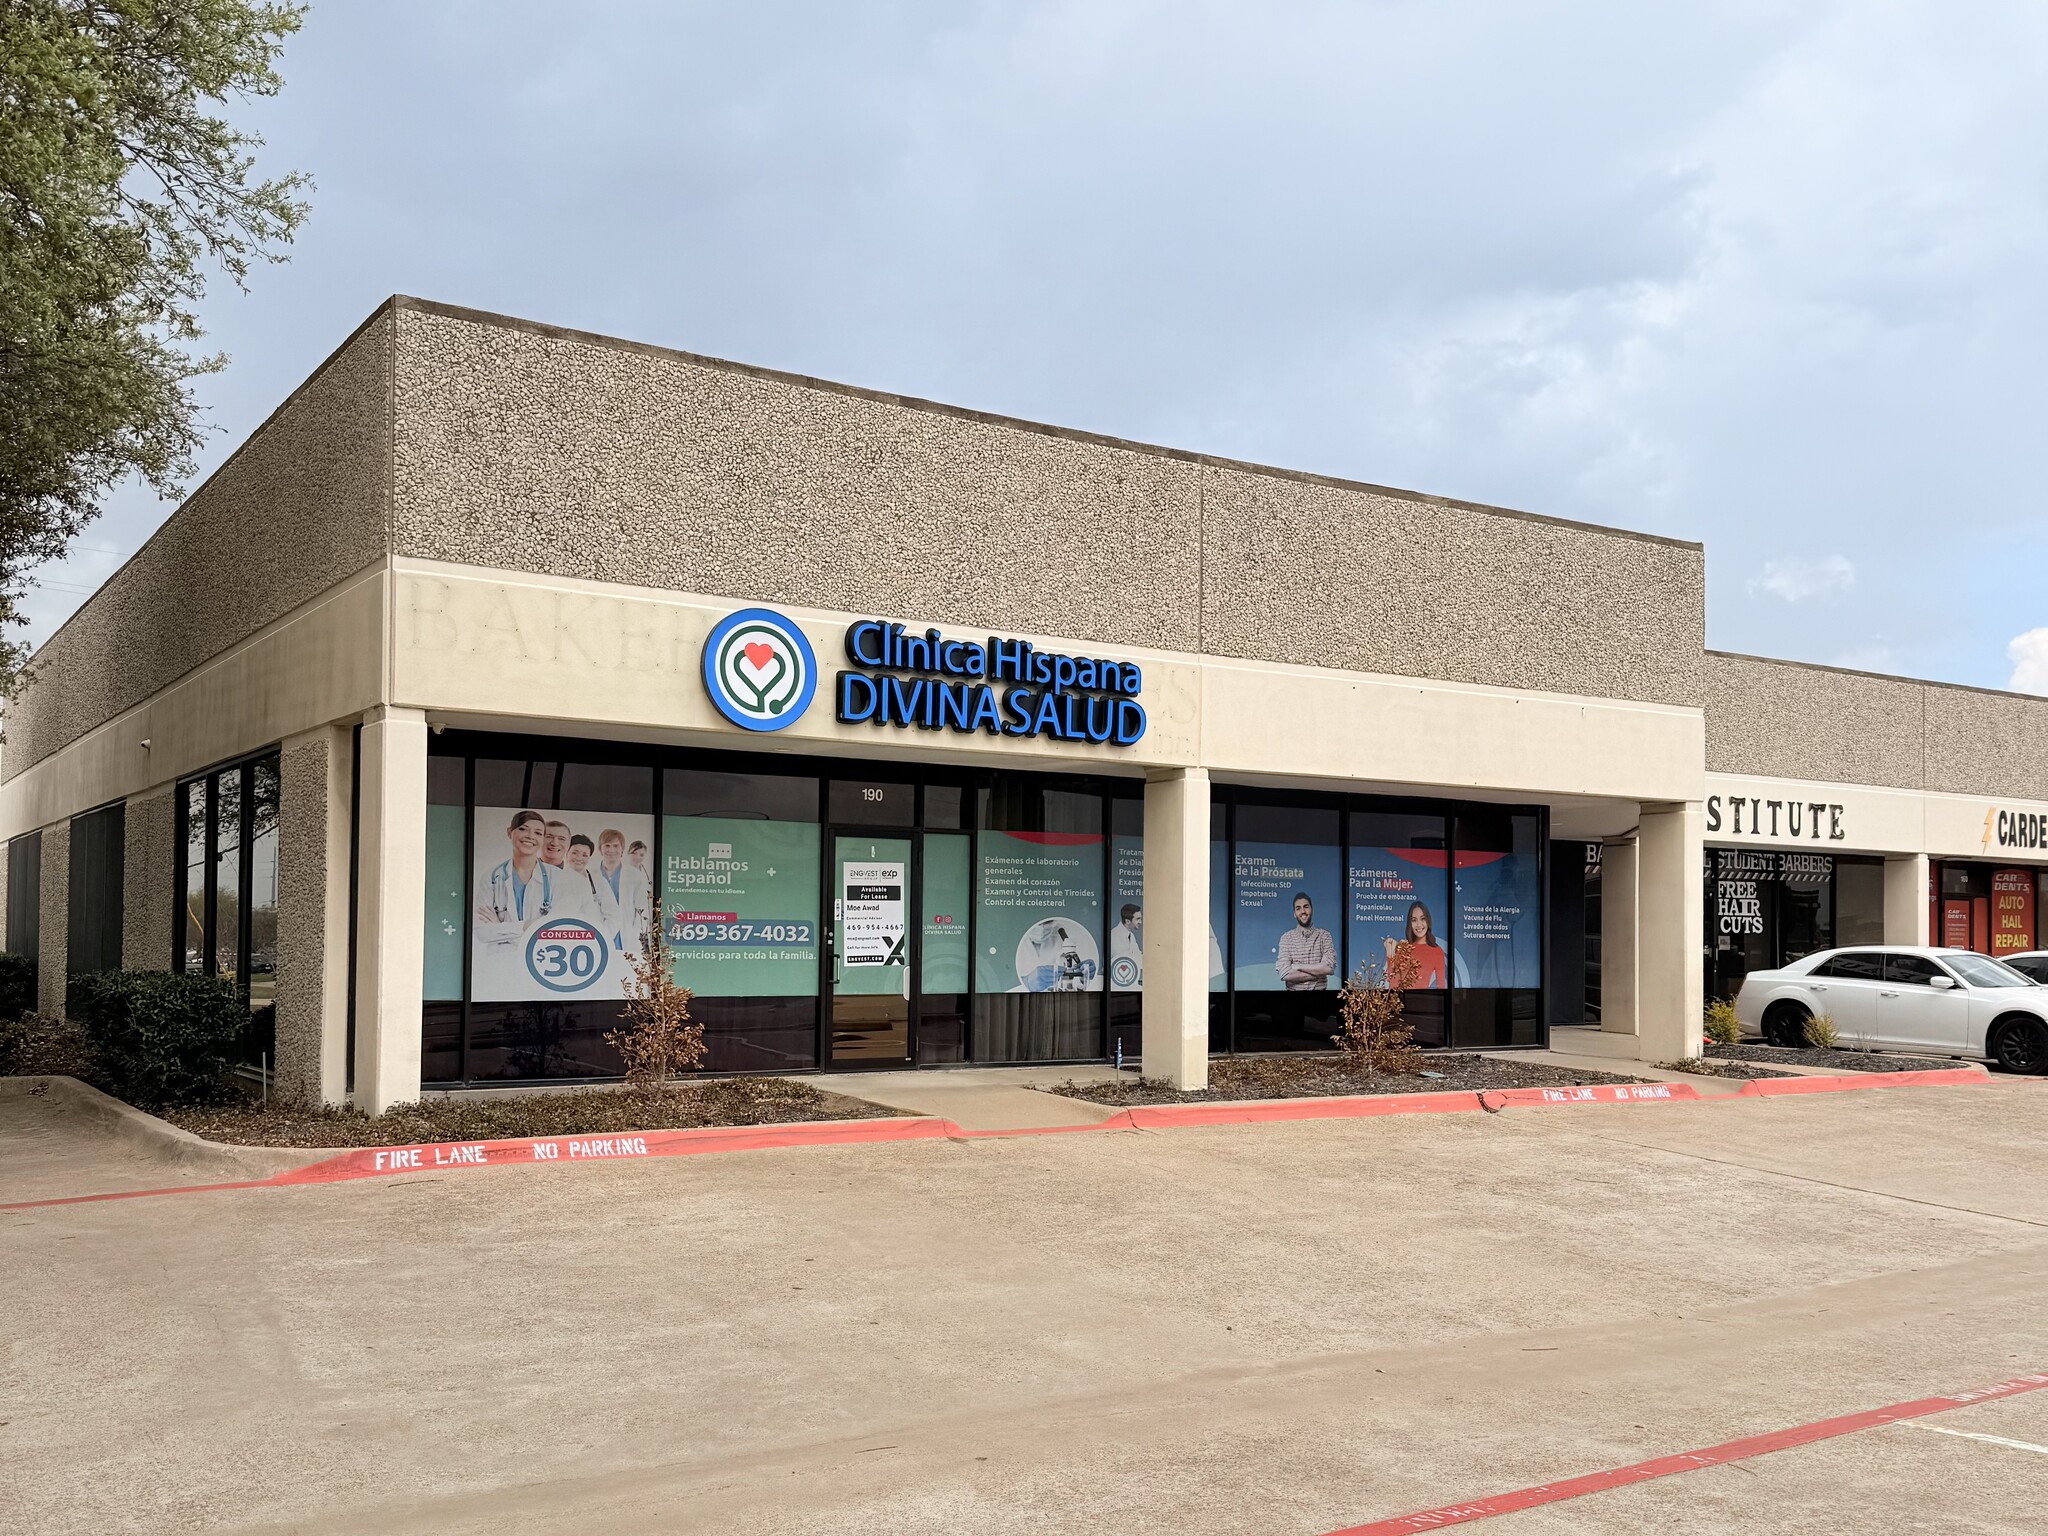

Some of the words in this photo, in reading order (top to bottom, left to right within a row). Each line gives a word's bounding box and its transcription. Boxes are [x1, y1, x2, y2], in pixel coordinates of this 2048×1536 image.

[849, 621, 986, 676] Clínica
[993, 638, 1142, 693] Hispana
[841, 673, 1001, 732] DIVINA
[1008, 688, 1147, 744] SALUD
[862, 788, 883, 801] 190
[1707, 795, 1845, 840] STITUTE
[1998, 810, 2047, 848] CARDE
[668, 856, 749, 871] Hablamos
[985, 856, 1024, 865] Exámenes
[1025, 857, 1035, 865] de
[1036, 858, 1080, 866] laboratorio
[1235, 854, 1276, 866] Examen
[1718, 850, 1775, 871] STUDENT
[984, 867, 1023, 875] generales
[1235, 865, 1248, 876] de
[1250, 865, 1260, 876] la
[1261, 866, 1304, 878] Próstata
[1349, 867, 1398, 878] Exámenes
[1995, 873, 2017, 882] CAR
[668, 870, 731, 887] Español
[985, 877, 1015, 885] Examen
[1016, 878, 1029, 886] del
[1030, 878, 1061, 886] corazón
[1349, 878, 1371, 888] Para
[1372, 878, 1382, 888] la
[1383, 879, 1413, 891] Mujer.
[985, 888, 1015, 896] Examen
[1023, 888, 1052, 896] Control
[1064, 889, 1095, 897] Tiroides
[1119, 888, 1134, 896] Test
[1240, 890, 1278, 898] Impotencia
[1718, 881, 1757, 898] FREE
[1994, 882, 2030, 893] DENTS
[984, 898, 1014, 906] Control
[1015, 898, 1026, 906] de
[1027, 899, 1066, 907] colesterol
[1356, 892, 1377, 900] Prueba
[1240, 899, 1263, 907] Sexual
[1356, 903, 1393, 912] Papanicolau
[1718, 899, 1761, 916] HAIR
[1999, 896, 2025, 910] AUTO
[687, 912, 727, 921] Llamanos
[2002, 915, 2023, 929] HAIL
[1720, 917, 1764, 934] CUTS
[541, 931, 593, 939] CONSULTA
[669, 923, 810, 942] 469-367-4032
[1995, 933, 2029, 948] REPAIR
[536, 945, 595, 977] $30
[669, 950, 716, 960] Servicios
[718, 952, 741, 961] para
[744, 951, 766, 960] toda
[769, 951, 778, 960] la
[781, 951, 817, 960] familia.
[1543, 1089, 1567, 1101] FIRE
[1569, 1088, 1597, 1101] LANE
[1614, 1087, 1629, 1100] NO
[1632, 1085, 1671, 1099] PARKING
[375, 1149, 423, 1171] FIRE
[435, 1145, 488, 1165] LANE
[533, 1142, 558, 1160] NO
[569, 1137, 647, 1157] PARKING
